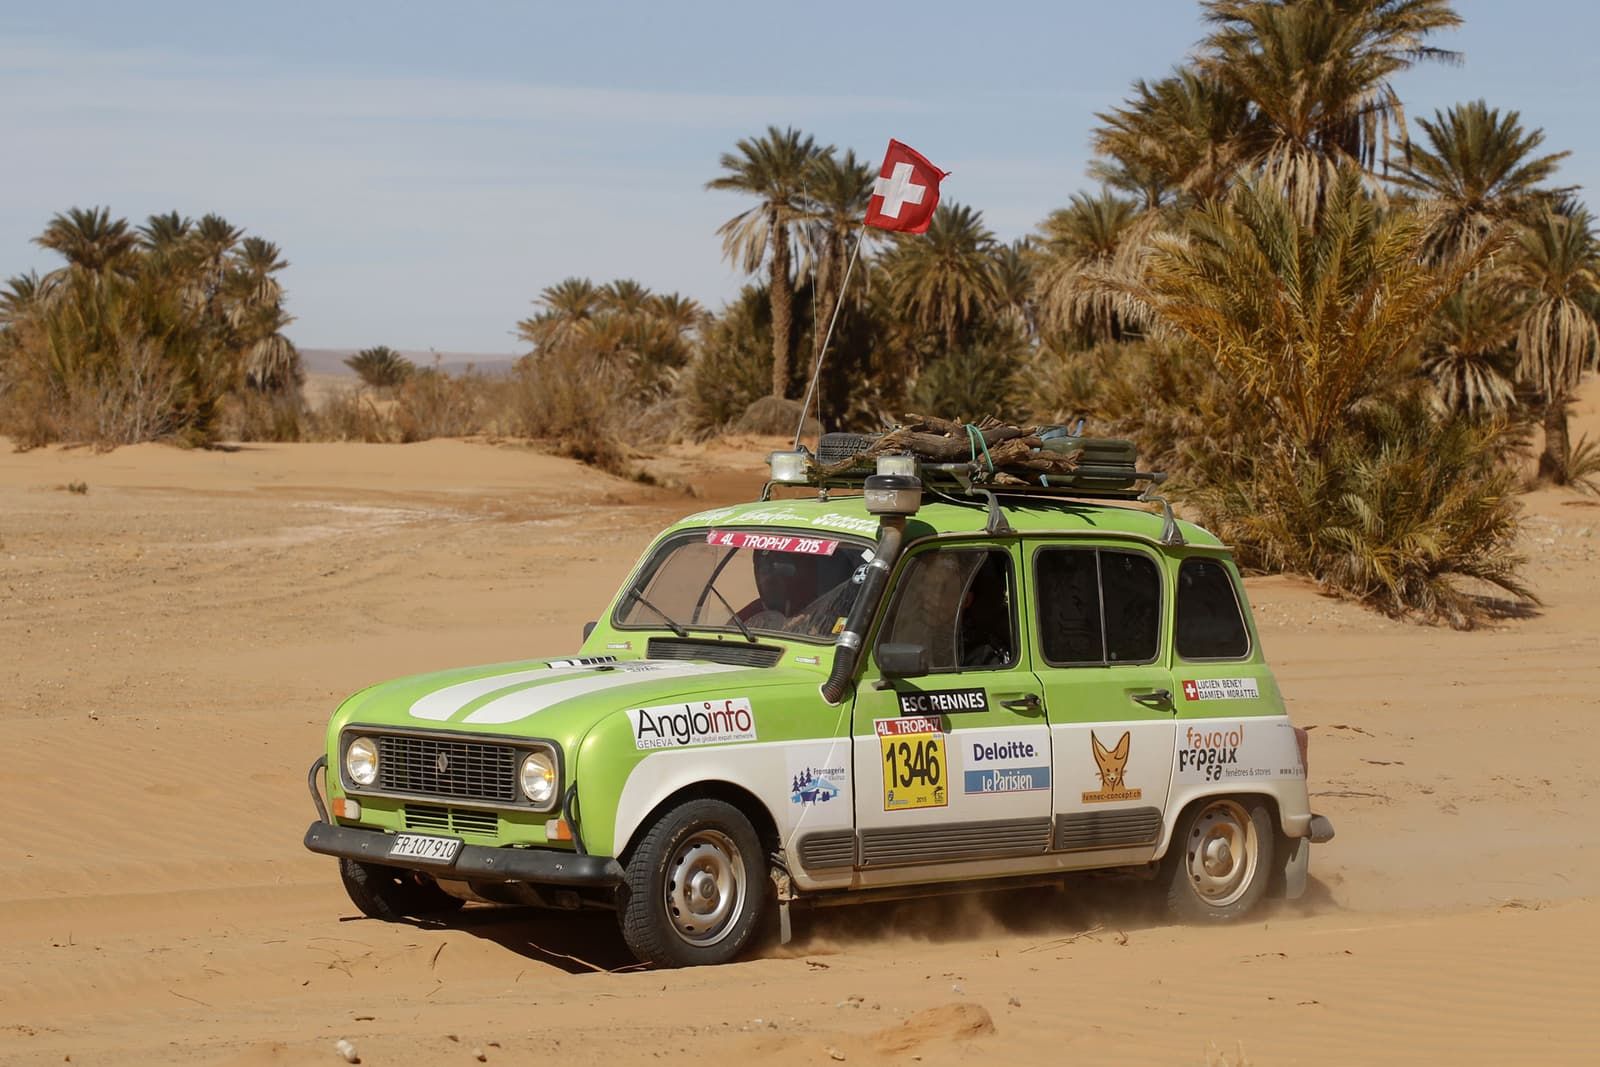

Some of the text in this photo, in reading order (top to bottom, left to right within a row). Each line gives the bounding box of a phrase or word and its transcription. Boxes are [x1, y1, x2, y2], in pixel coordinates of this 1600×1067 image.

[720, 533, 823, 553] 4L TROPHY 2015
[1197, 679, 1242, 689] LUCIEN BENEY
[901, 692, 985, 712] ESC RENNES
[1200, 689, 1258, 699] DAMIEN MORATTEL
[637, 700, 751, 745] Angloinfo
[877, 719, 938, 735] 4L TROPHY
[637, 739, 673, 749] GENEVA
[1186, 724, 1243, 749] favorol
[886, 740, 940, 788] 1346
[1179, 748, 1237, 772] papaux
[813, 767, 845, 775] Fromagerie
[1206, 764, 1222, 781] sa
